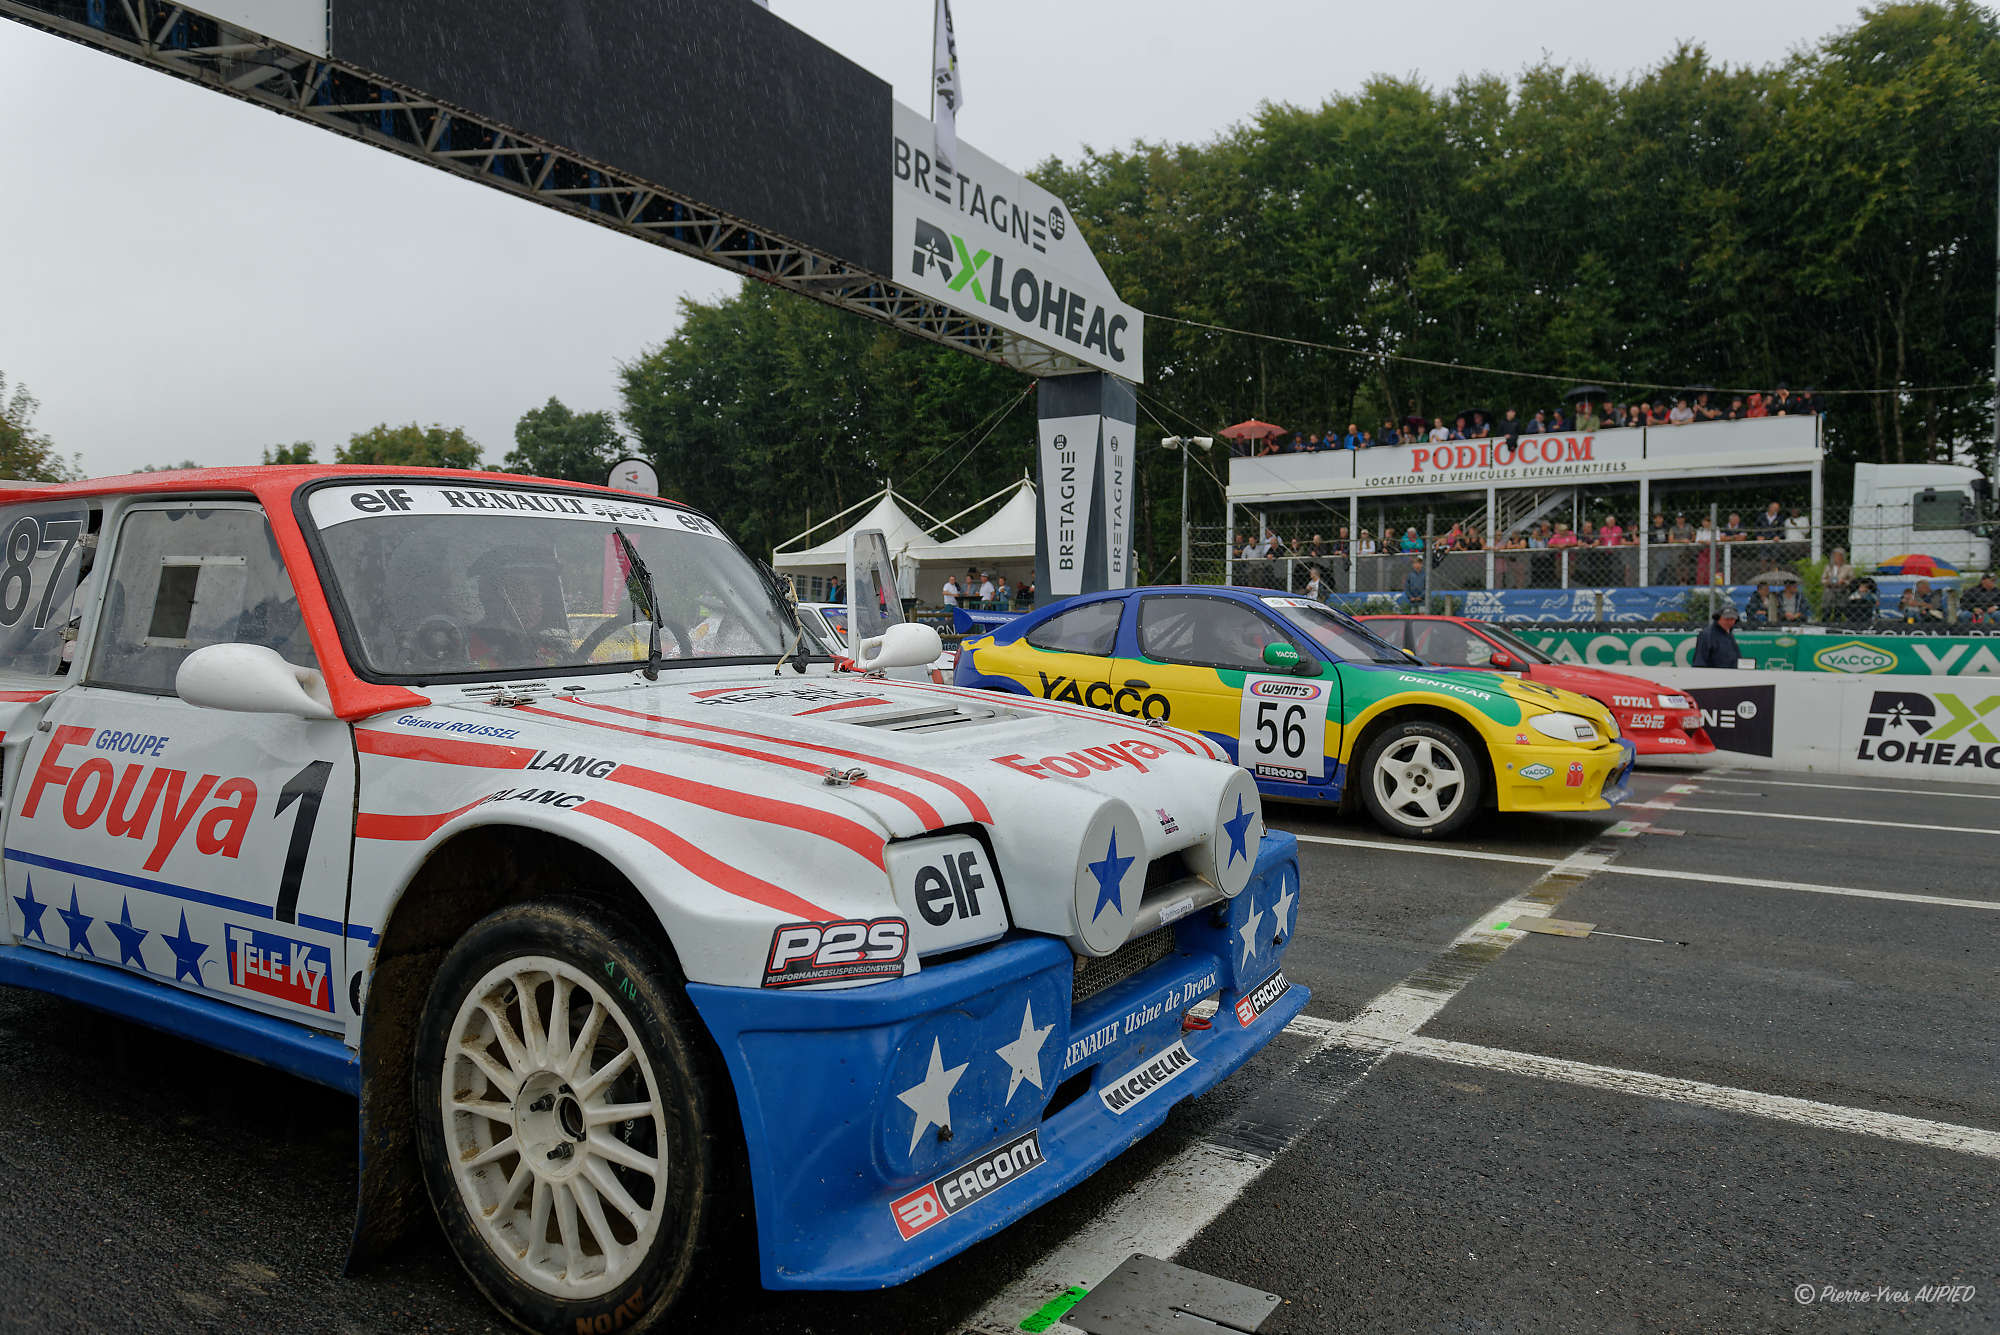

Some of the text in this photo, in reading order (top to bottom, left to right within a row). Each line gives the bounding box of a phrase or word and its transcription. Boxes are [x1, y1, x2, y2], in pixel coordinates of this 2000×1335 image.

[894, 136, 1047, 254] BRETAGNE
[1411, 436, 1595, 473] PODIOCOM
[1365, 475, 1425, 487] LOCATION
[1431, 473, 1444, 483] DE
[351, 488, 414, 512] elf
[438, 489, 589, 515] RENAULT
[676, 514, 713, 535] elf
[1060, 451, 1076, 570] BRETAGNE
[1113, 454, 1123, 573] BRETAGNE
[0, 517, 83, 630] 87
[1275, 650, 1298, 659] YACCO
[1827, 654, 1886, 667] YACCO
[1038, 671, 1171, 721] YACCO
[1398, 675, 1491, 701] IDENTICAR
[1612, 695, 1653, 708] TOTAL
[95, 729, 170, 757] GROUPE
[397, 714, 520, 740] Gérard ROUSSEL
[1254, 701, 1307, 758] 56
[1658, 737, 1687, 745] GEFCO
[527, 750, 618, 779] LANG
[990, 739, 1170, 780] Fouya
[1258, 765, 1304, 779] FERODO
[20, 724, 258, 872] Fouya
[273, 759, 334, 925] 1
[914, 851, 985, 927] elf
[771, 923, 904, 970] P2S
[1252, 974, 1290, 1012] FACOM
[1063, 972, 1216, 1070] RENAULT Usine de Dreux
[1105, 1046, 1192, 1111] MICHELIN
[943, 1138, 1039, 1208] FACOM
